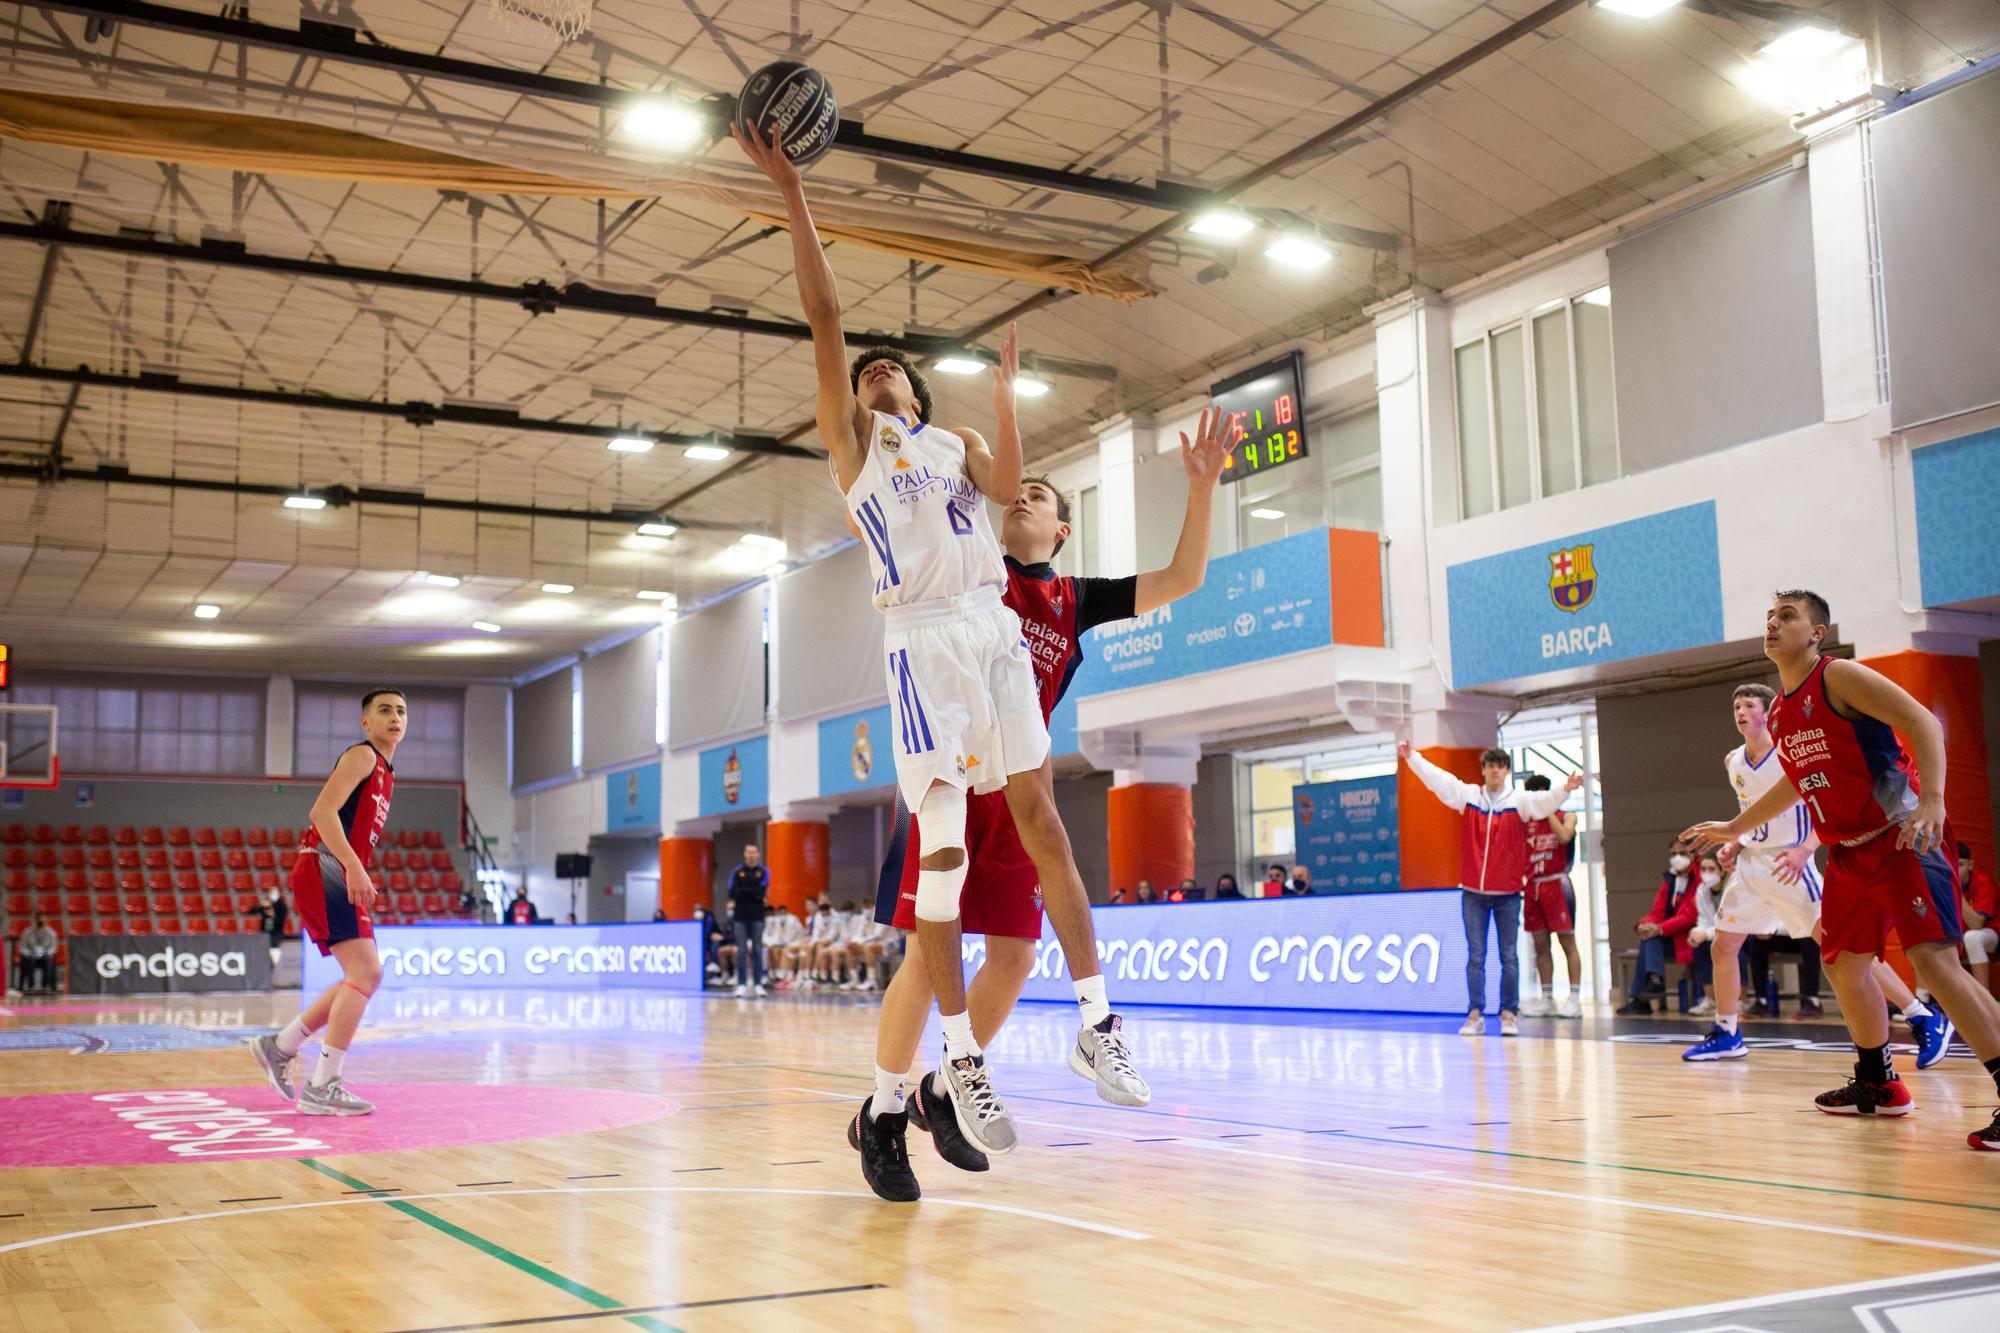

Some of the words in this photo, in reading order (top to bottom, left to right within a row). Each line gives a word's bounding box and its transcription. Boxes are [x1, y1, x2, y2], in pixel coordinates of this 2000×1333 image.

[786, 92, 836, 157] SPALDING
[1273, 395, 1292, 426] 18
[1244, 443, 1259, 470] 4
[1266, 432, 1286, 464] 13
[1286, 429, 1299, 456] 2
[945, 498, 974, 536] 6
[1103, 631, 1163, 663] endesa
[1186, 626, 1227, 646] endesa
[1541, 622, 1613, 659] BARÇA
[96, 946, 247, 978] endesa
